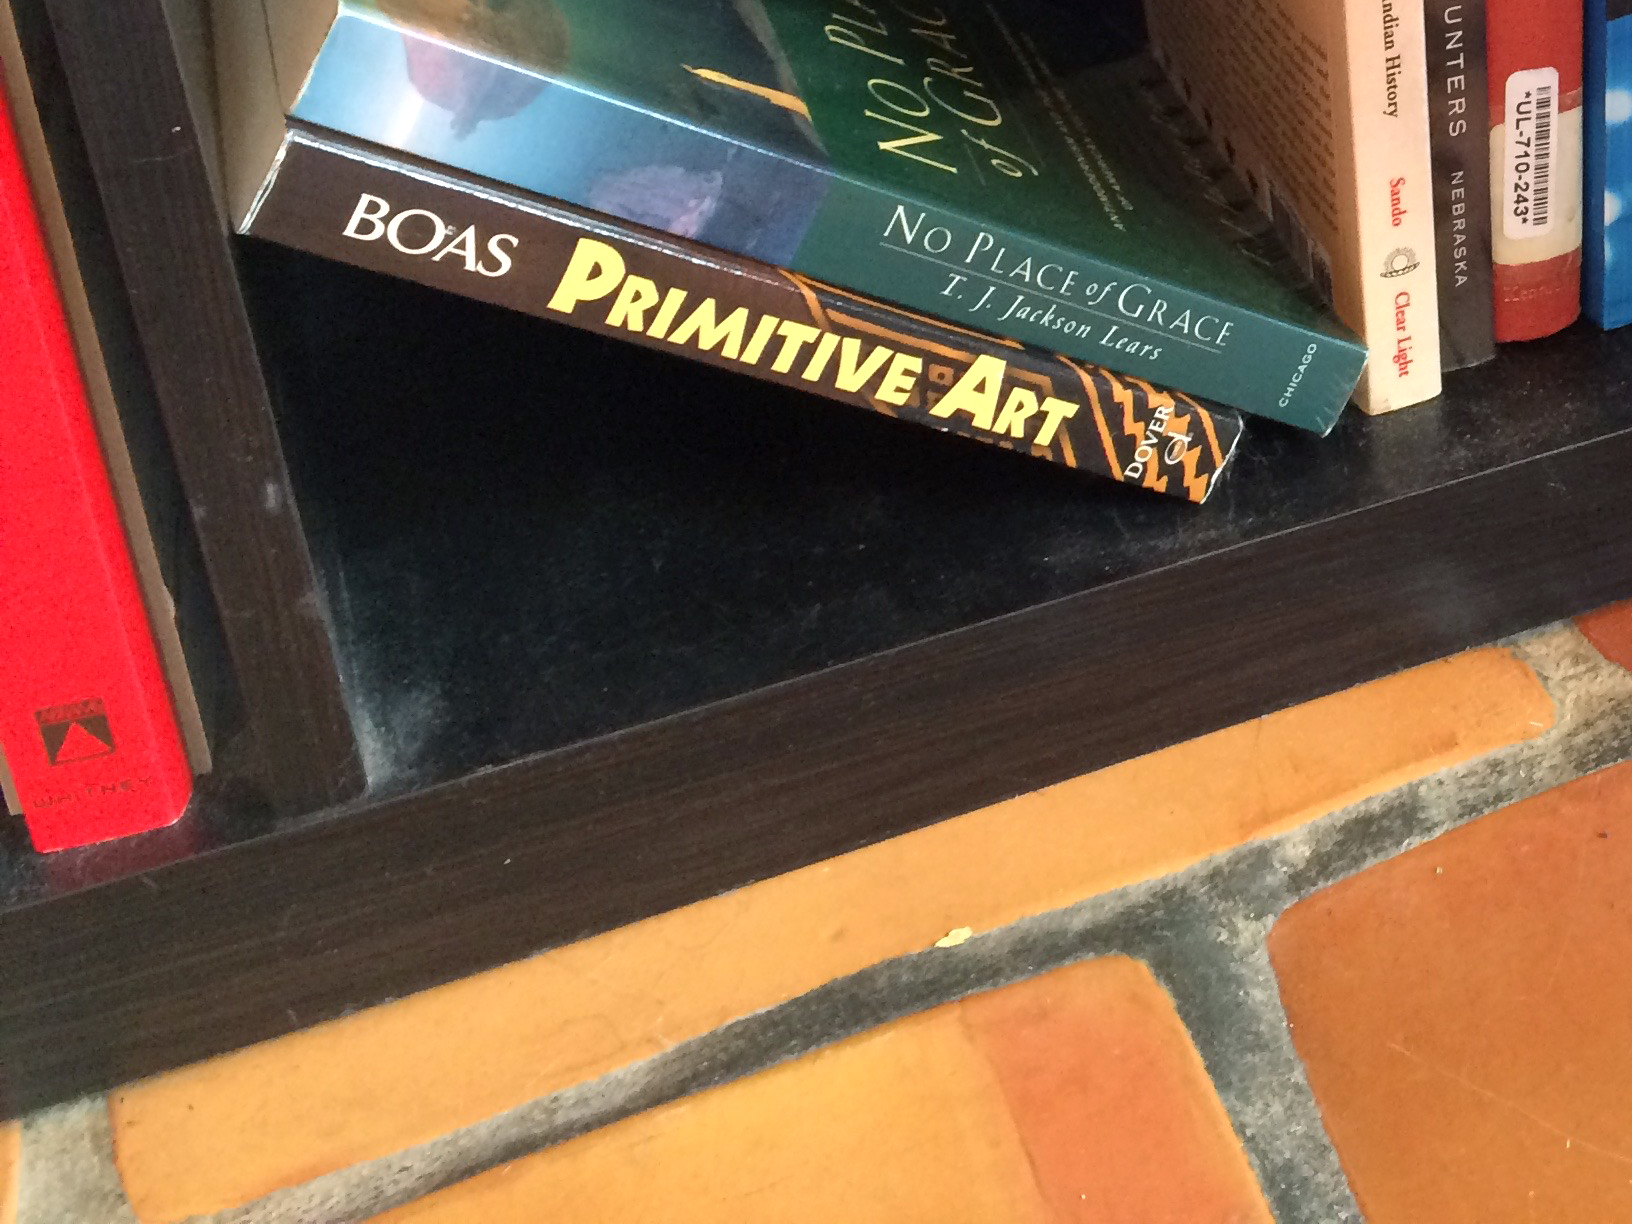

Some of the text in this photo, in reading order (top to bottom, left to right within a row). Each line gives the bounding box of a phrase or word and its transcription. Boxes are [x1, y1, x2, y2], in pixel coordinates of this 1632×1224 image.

[864, 78, 958, 174] NO
[1383, 53, 1402, 118] History
[960, 129, 1039, 177] of
[342, 193, 519, 278] BOAS
[1389, 177, 1409, 227] Sando
[1450, 170, 1469, 288] NEBRASKA
[882, 205, 1235, 347] NO PLACE of GRACE
[939, 273, 1163, 361] T. J. Jackson Lears
[546, 237, 1080, 448] PRIMITIVE ART
[1278, 343, 1318, 408] CHICAGO
[1392, 291, 1416, 378] Clear Light
[1124, 404, 1175, 480] DOVER
